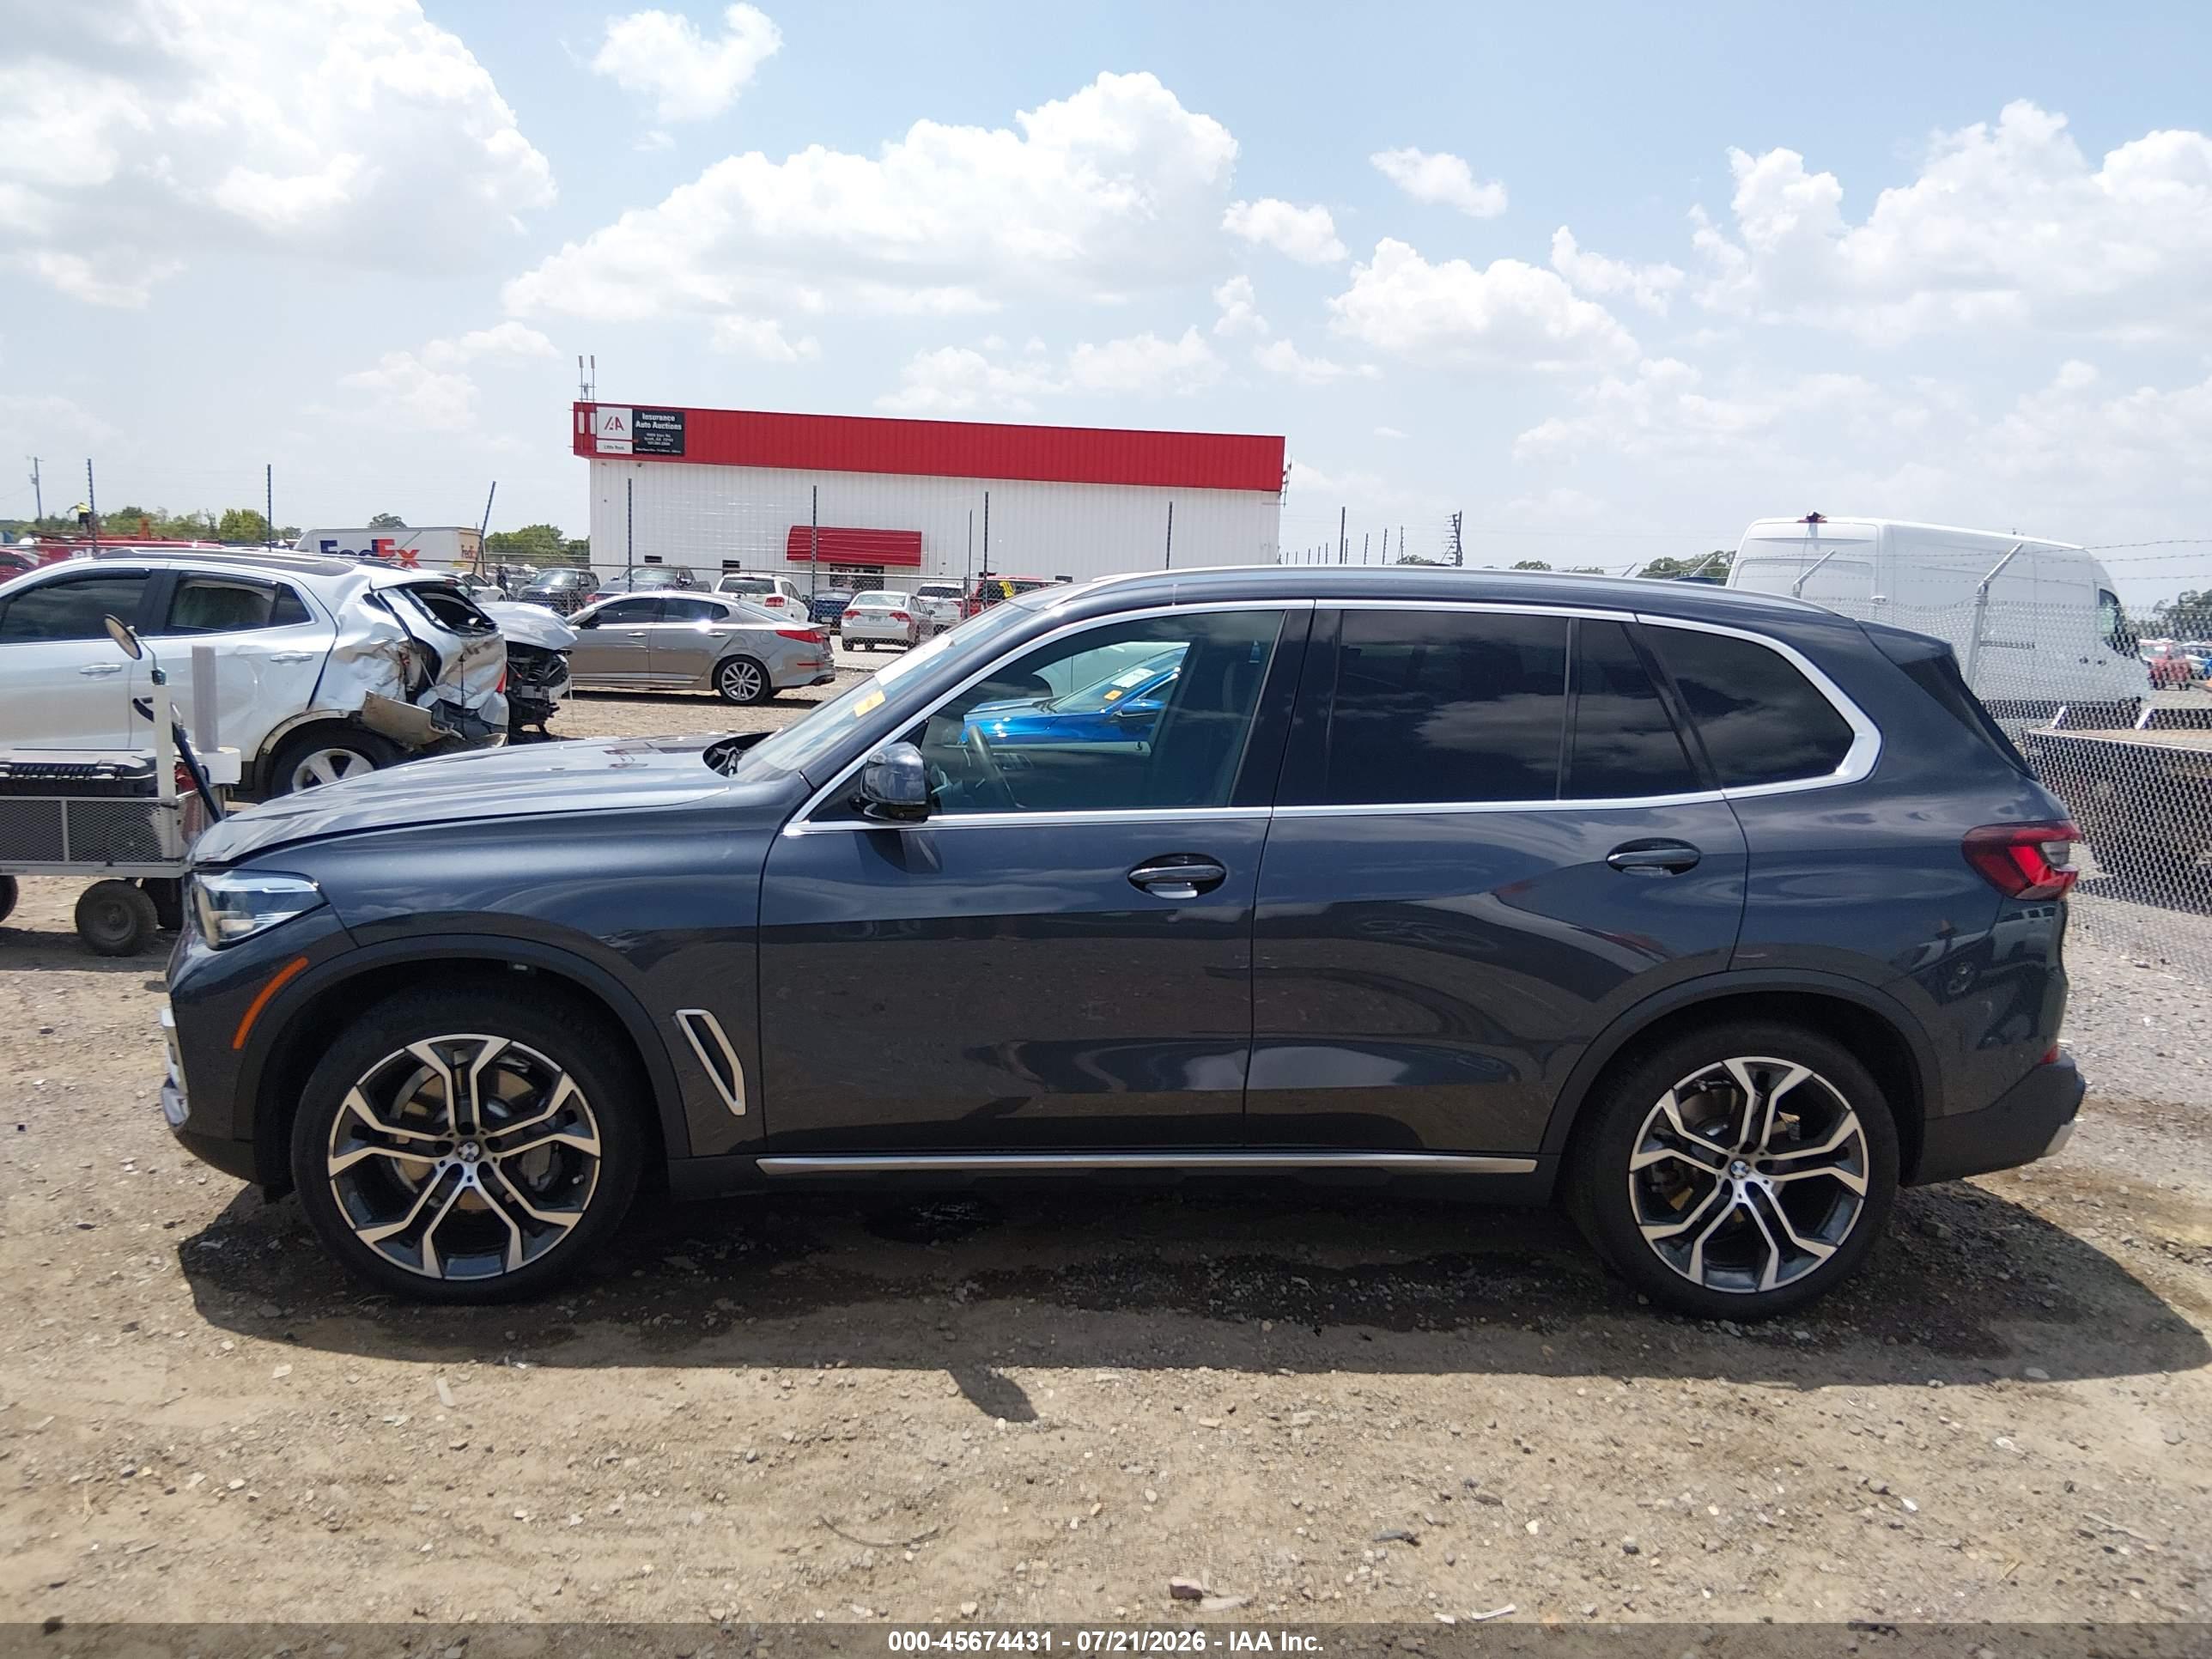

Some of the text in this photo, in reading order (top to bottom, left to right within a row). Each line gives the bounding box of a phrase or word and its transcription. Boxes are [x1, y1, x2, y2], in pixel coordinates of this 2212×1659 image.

[642, 412, 675, 422] Insurance
[635, 420, 682, 430] Auto Auctions
